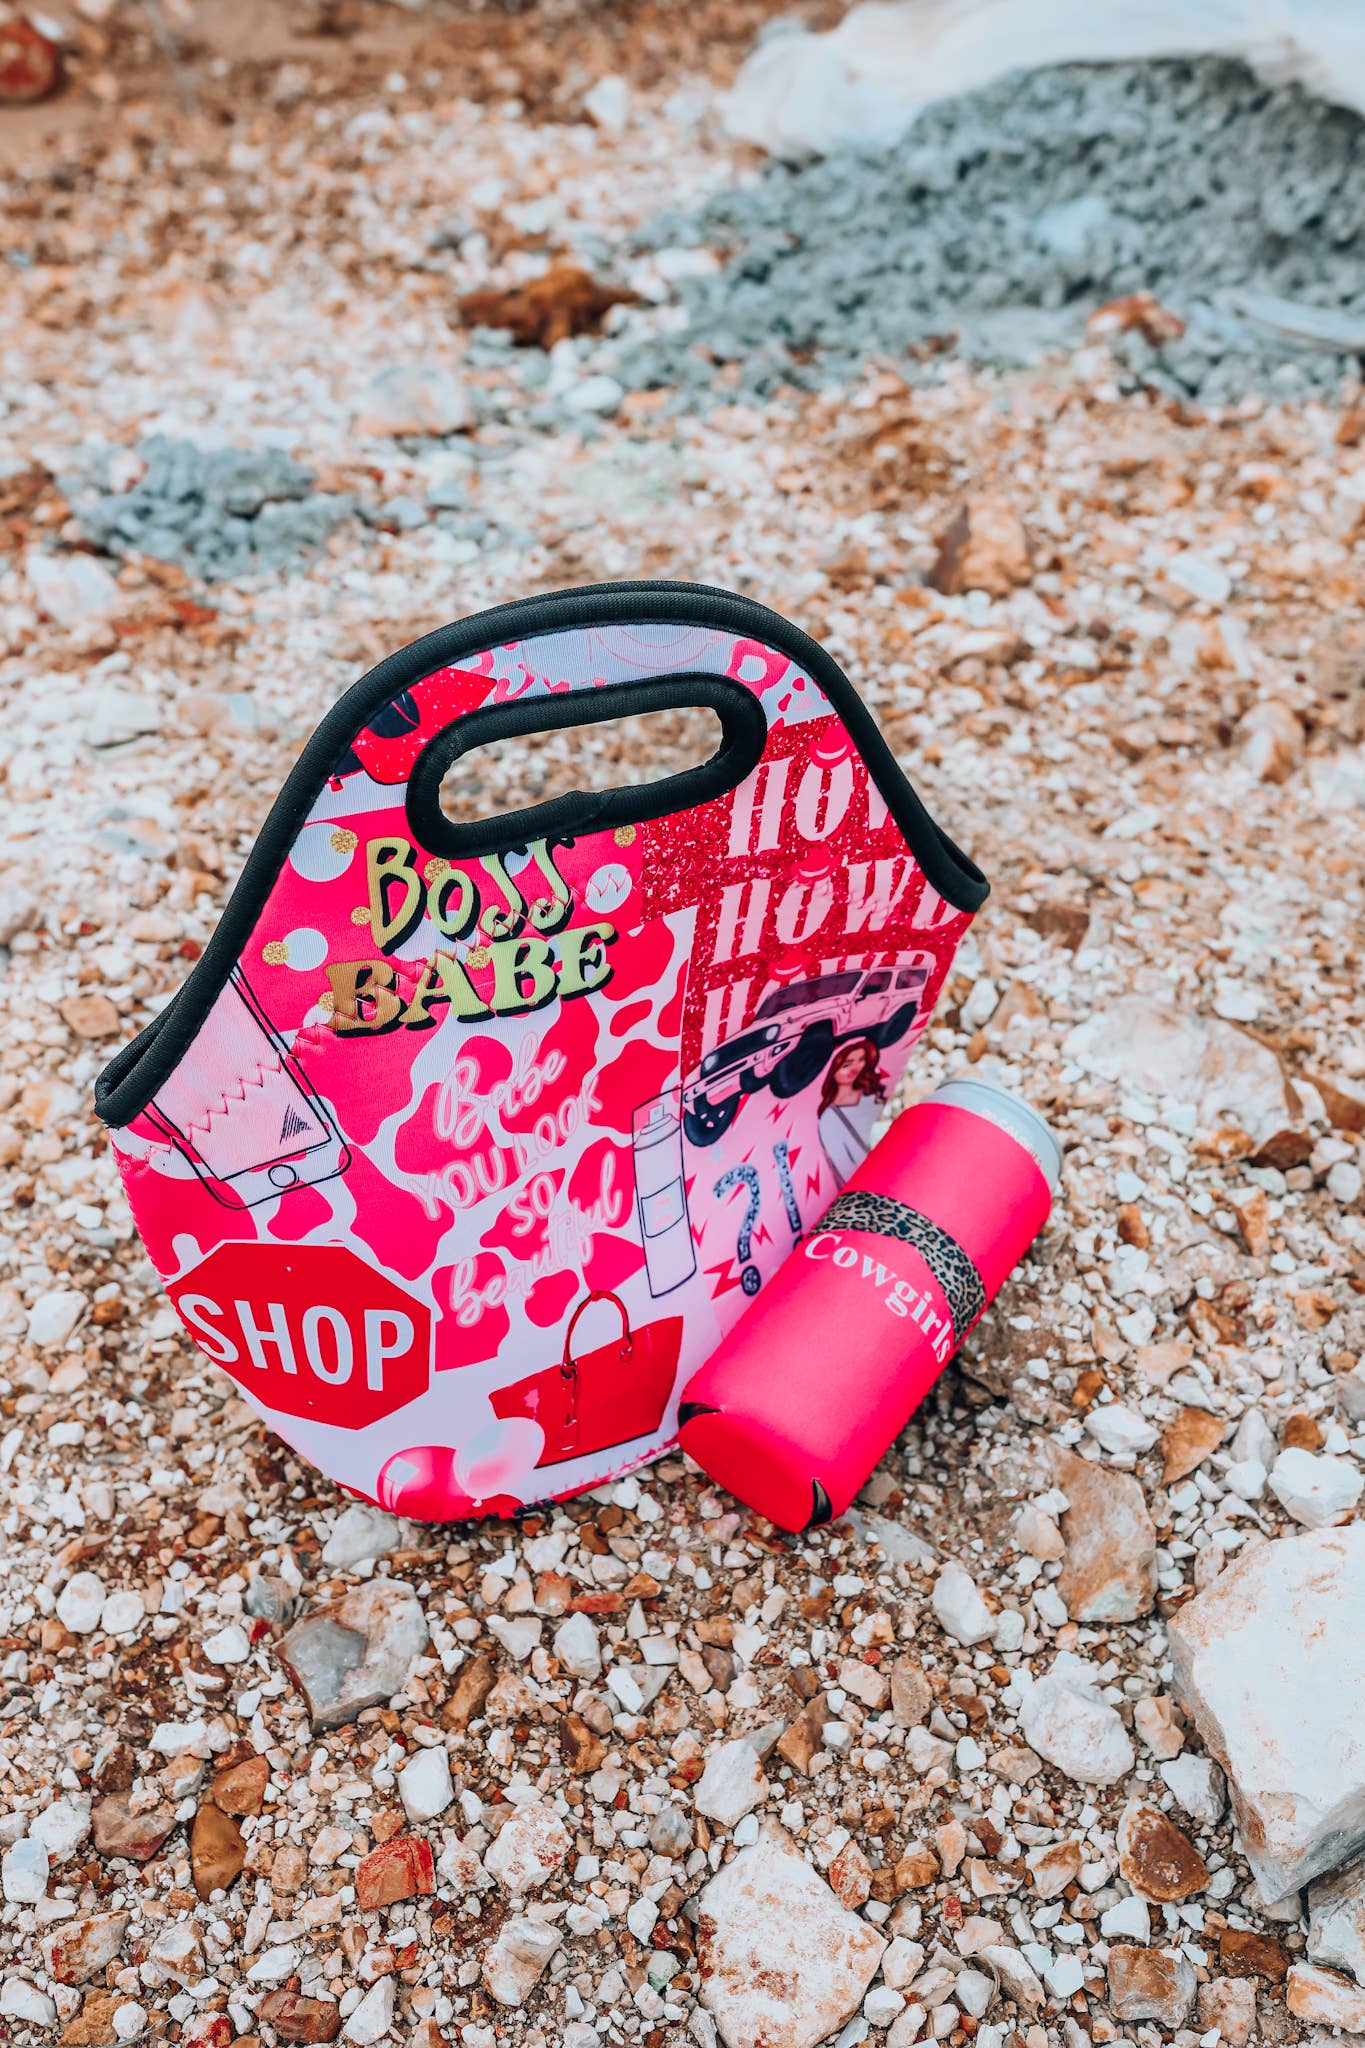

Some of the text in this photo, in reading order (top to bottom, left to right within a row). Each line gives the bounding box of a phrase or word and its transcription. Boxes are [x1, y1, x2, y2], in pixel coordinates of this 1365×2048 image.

[325, 922, 617, 1037] BABE
[433, 1031, 567, 1149] Babe
[408, 1145, 506, 1220] YOU
[178, 1294, 415, 1391] SHOP
[804, 1232, 951, 1363] Cowgirls
